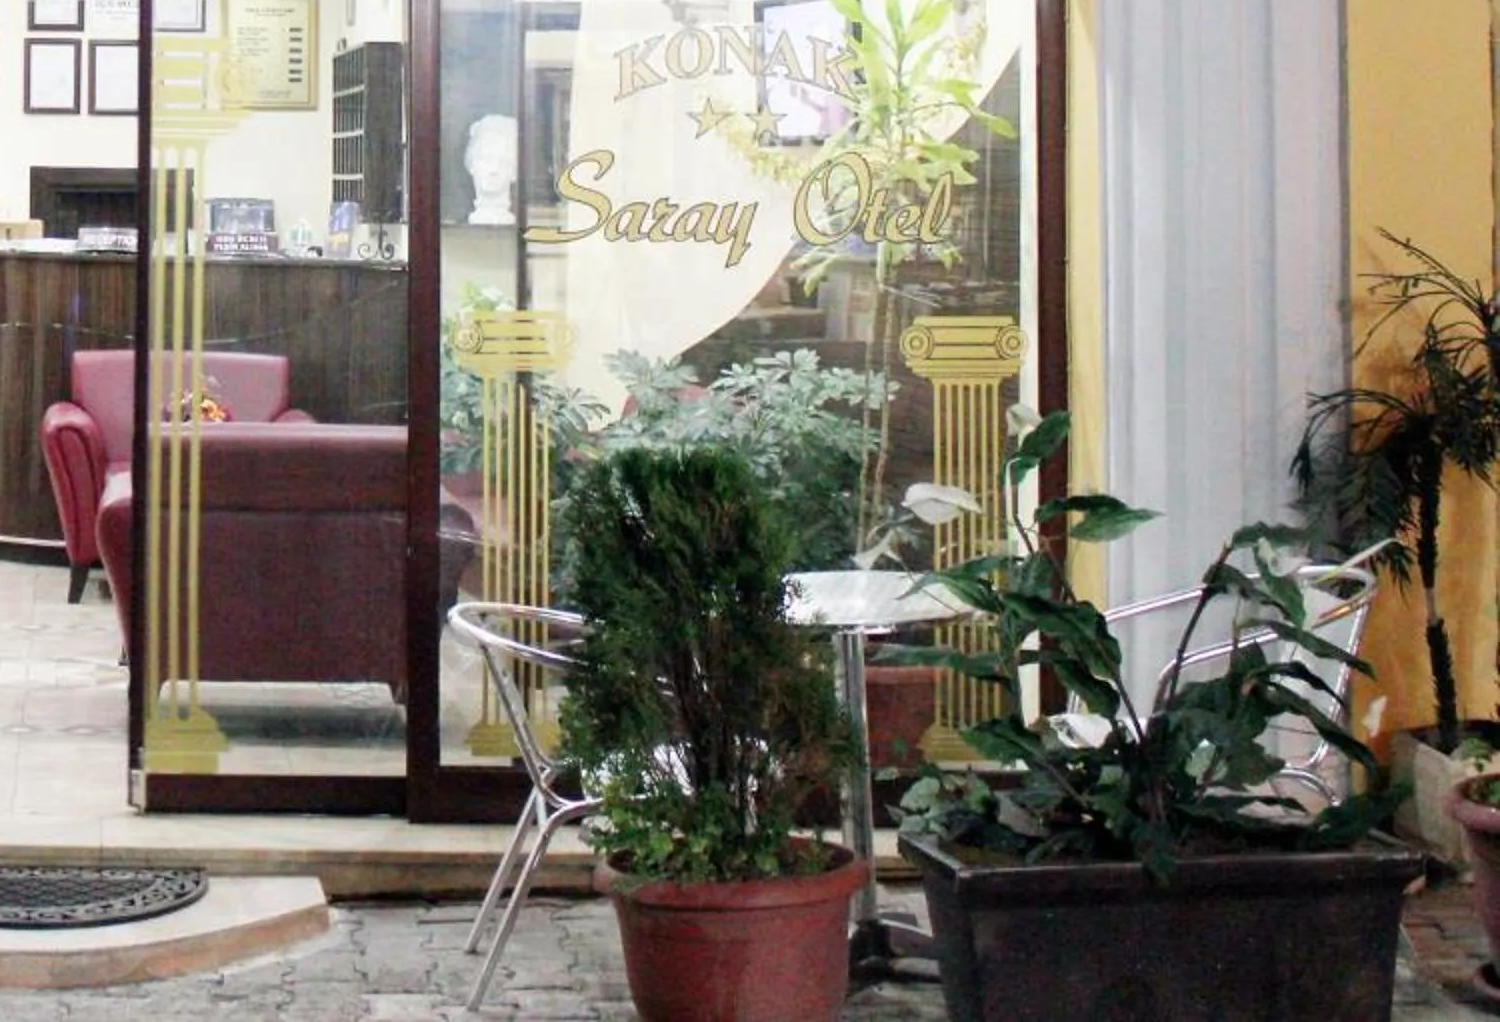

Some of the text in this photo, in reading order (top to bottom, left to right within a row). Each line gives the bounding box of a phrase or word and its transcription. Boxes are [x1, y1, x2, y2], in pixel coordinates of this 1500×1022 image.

[612, 24, 858, 102] KONAK
[524, 149, 953, 268] Saray Otel
